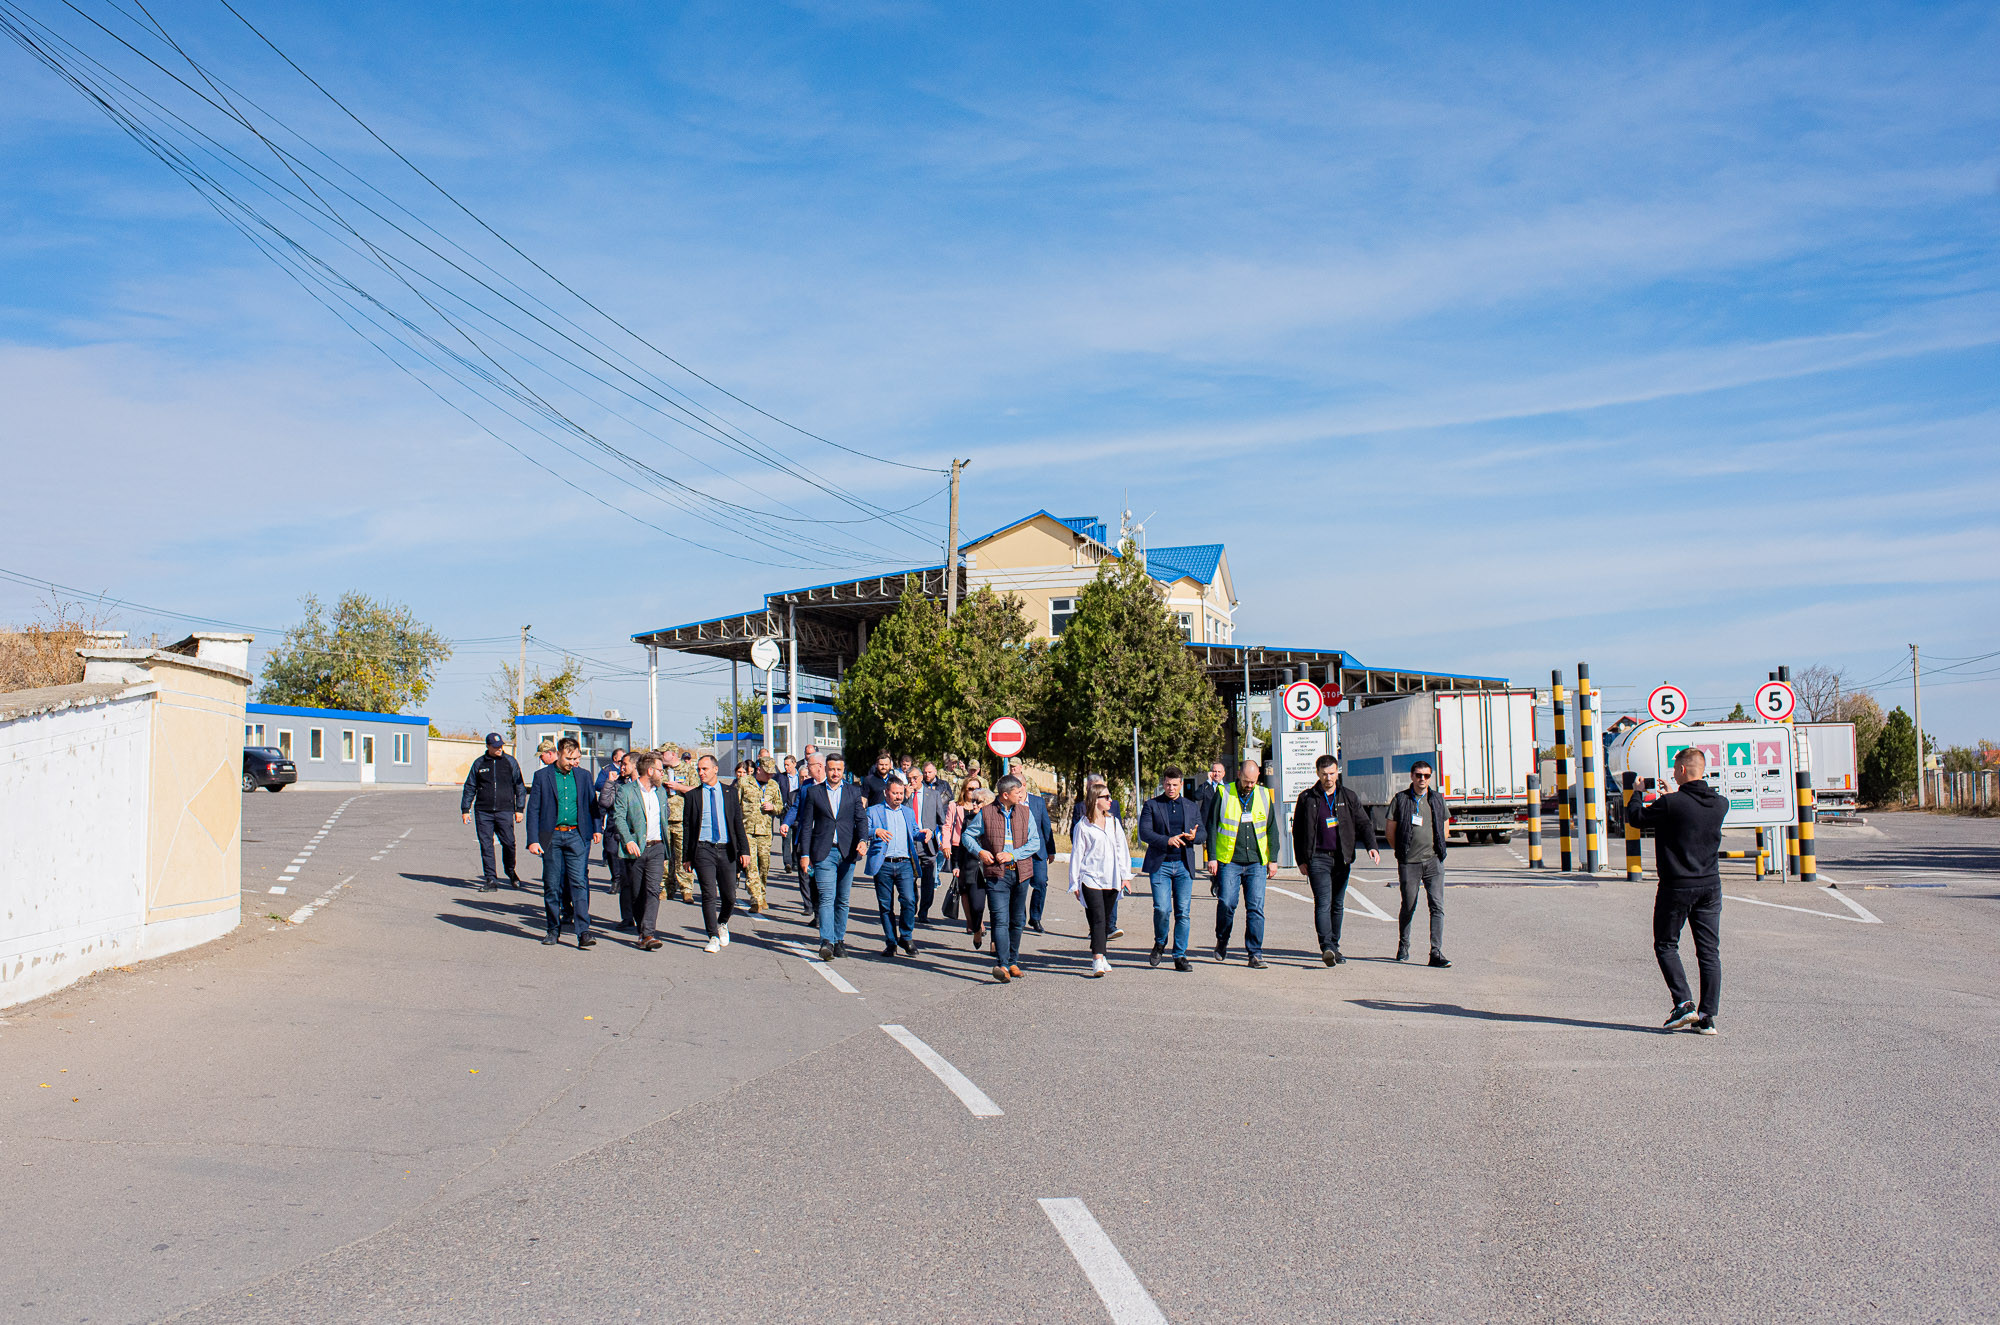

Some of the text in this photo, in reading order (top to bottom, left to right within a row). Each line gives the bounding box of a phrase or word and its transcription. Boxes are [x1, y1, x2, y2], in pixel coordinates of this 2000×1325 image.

[1296, 691, 1310, 711] 5
[1661, 694, 1675, 714] 5
[1768, 691, 1782, 711] 5
